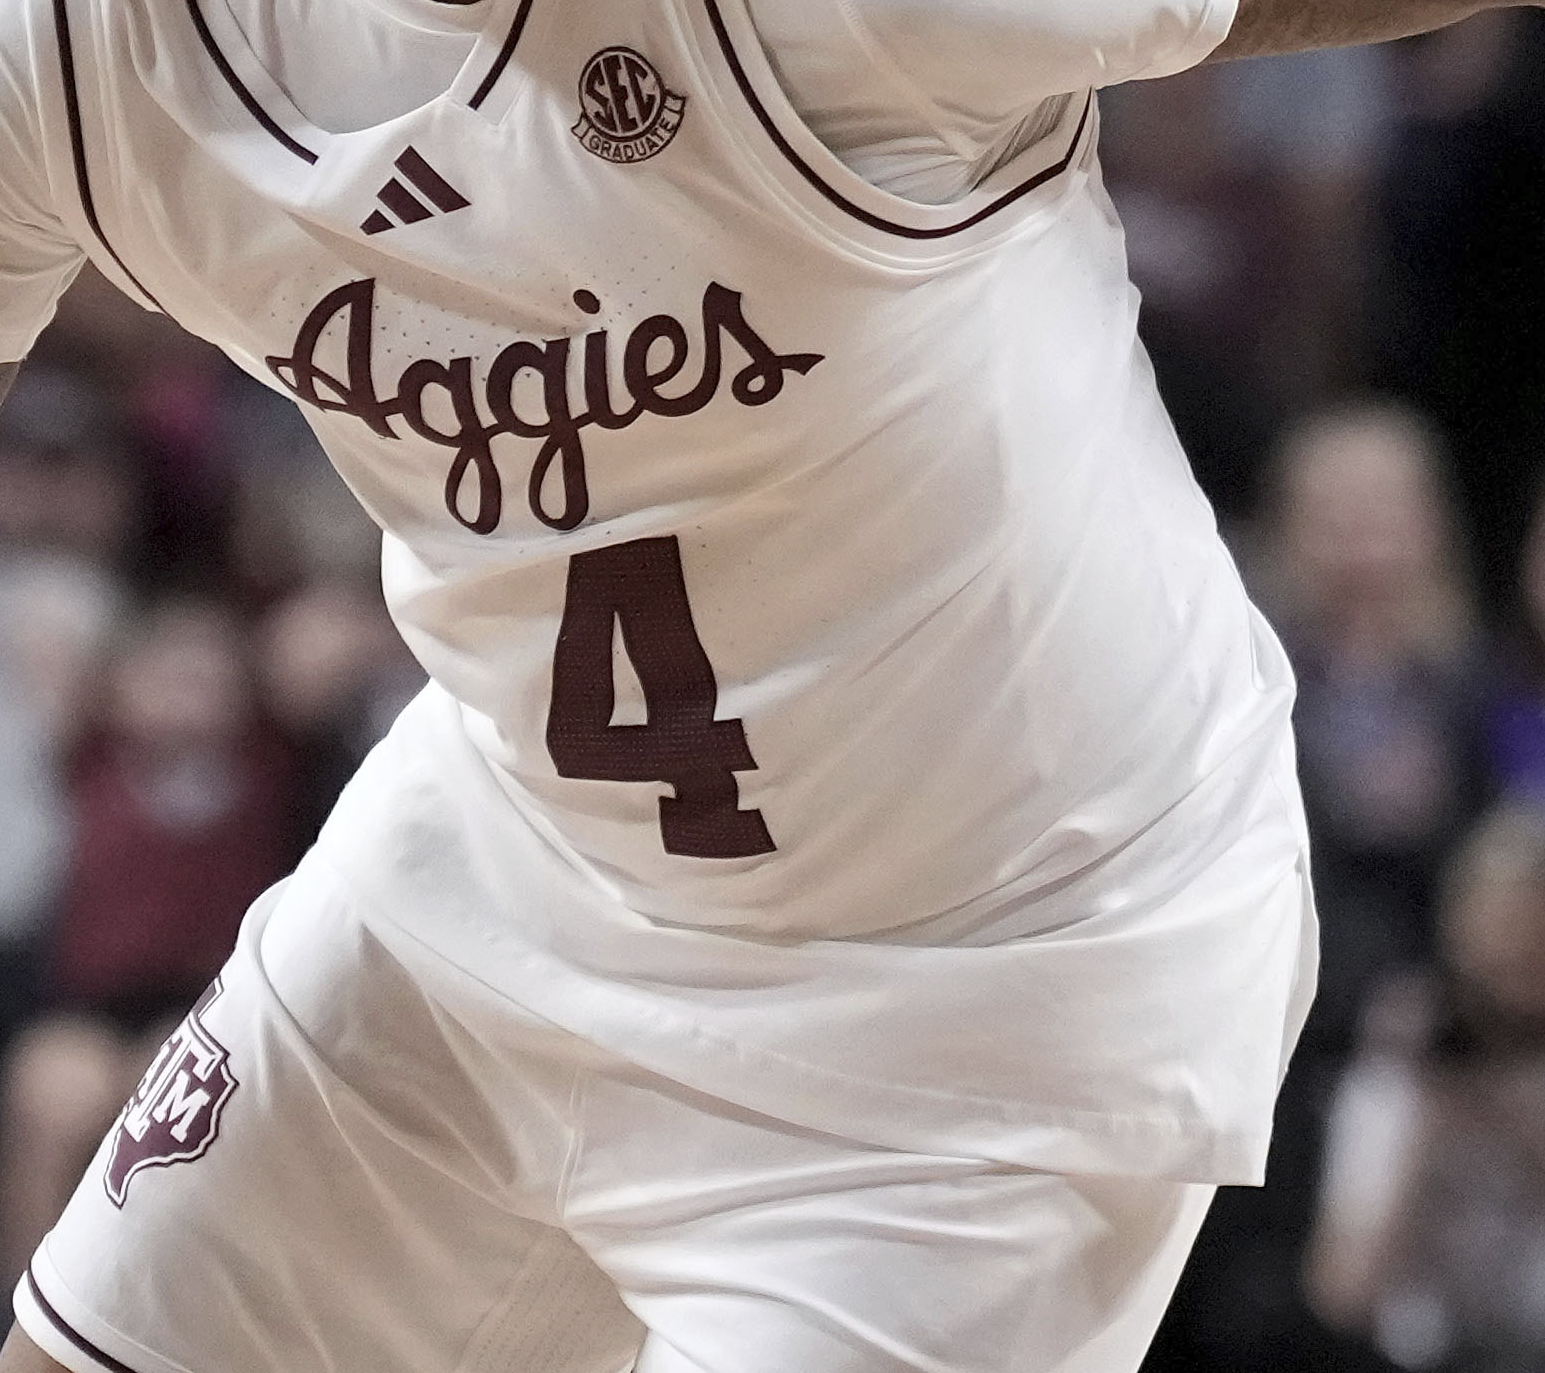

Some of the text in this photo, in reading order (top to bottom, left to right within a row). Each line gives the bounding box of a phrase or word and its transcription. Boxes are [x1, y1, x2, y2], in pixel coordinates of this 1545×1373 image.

[585, 54, 656, 133] SEC
[588, 117, 675, 160] GRADUATE
[265, 278, 826, 535] Aggies
[546, 535, 777, 859] 4
